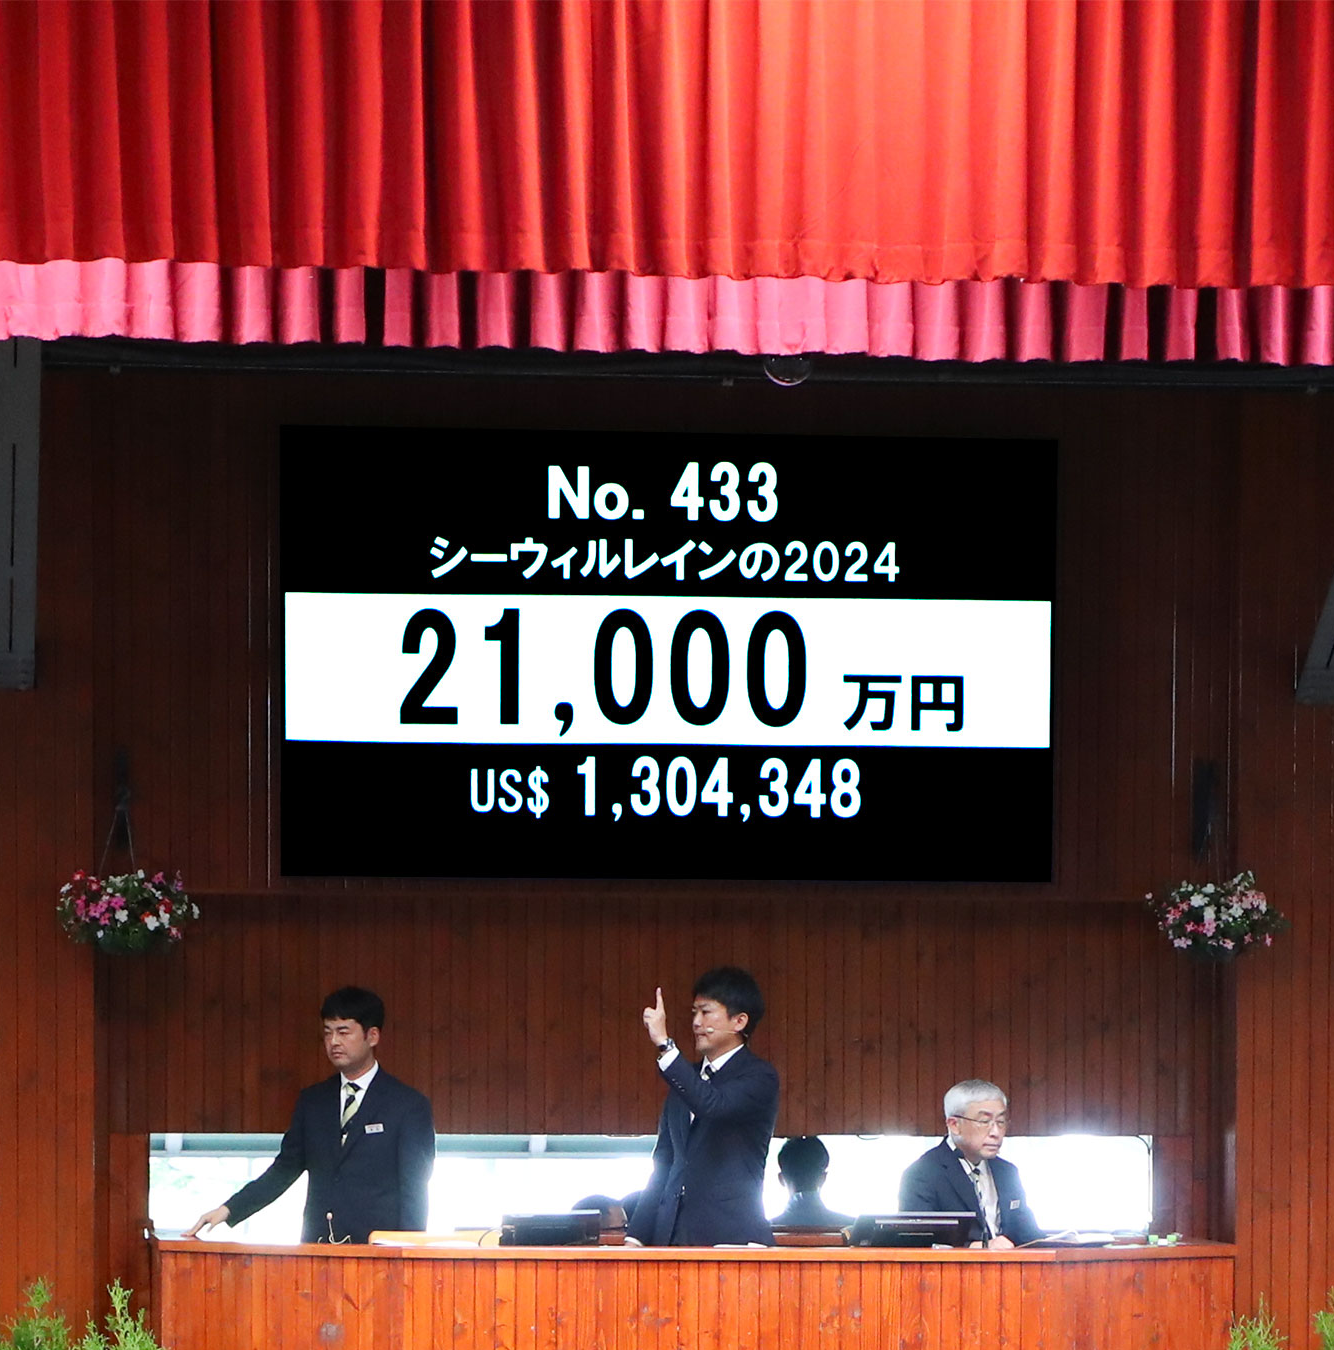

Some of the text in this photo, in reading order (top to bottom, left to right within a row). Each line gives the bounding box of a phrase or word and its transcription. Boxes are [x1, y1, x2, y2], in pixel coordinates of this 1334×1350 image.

[547, 461, 779, 523] No. 433
[429, 536, 900, 583] シーウィルレインの2024
[399, 608, 964, 737] 21,000 万円
[470, 755, 862, 823] US$ 1,304,348
